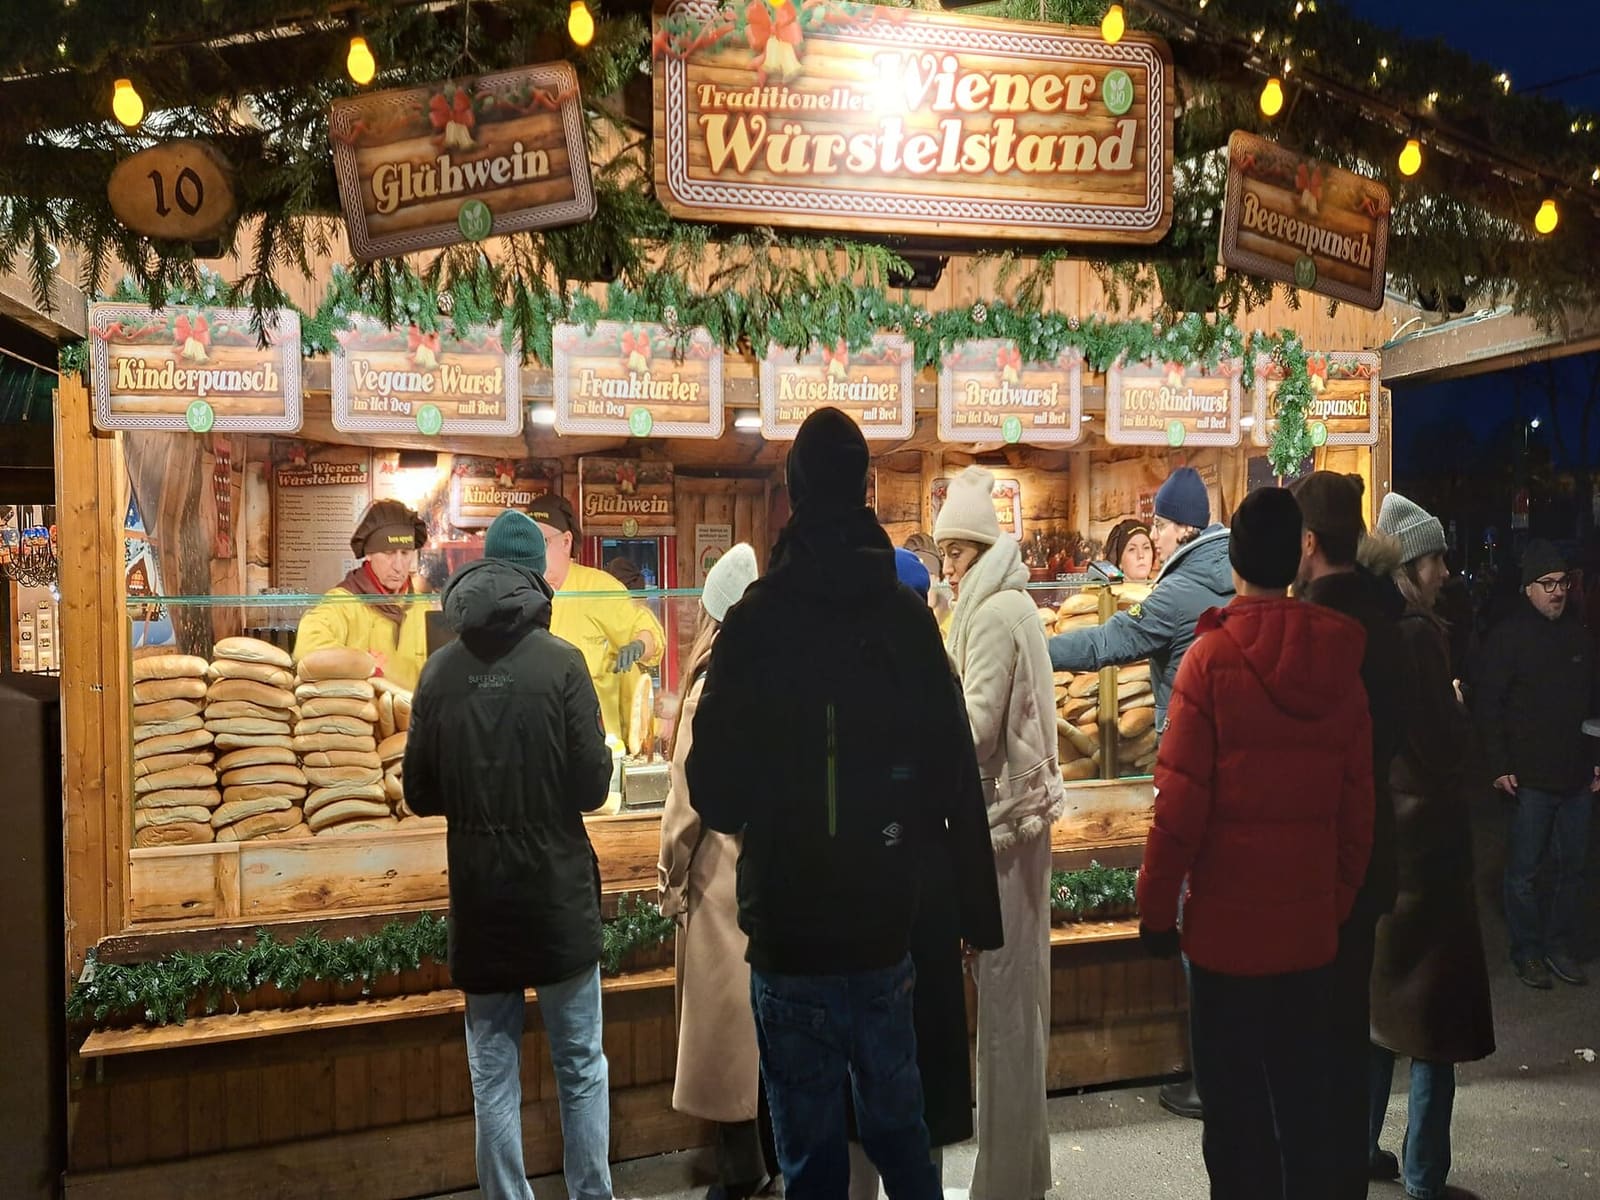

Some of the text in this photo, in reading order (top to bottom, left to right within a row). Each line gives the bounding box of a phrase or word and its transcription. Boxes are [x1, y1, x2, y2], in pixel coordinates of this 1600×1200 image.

[697, 51, 1096, 112] Traditioneller Wiener
[699, 114, 1138, 174] Würstelstand
[371, 141, 550, 214] Glühwein
[147, 167, 204, 217] 10
[1243, 191, 1372, 269] Beerenpunsch
[117, 358, 278, 397] Kinderpunsch
[352, 360, 503, 396] Vegane Wurst
[580, 369, 700, 401] Frankfurter
[779, 373, 899, 401] Käsekrainer
[390, 398, 412, 415] Dog
[965, 380, 1059, 407] Bratwurst
[1124, 386, 1229, 413] 100% Rindwurst
[458, 400, 499, 415] mit Brot
[606, 402, 625, 417] Dog
[879, 407, 897, 420] Brot
[983, 412, 1000, 426] Dog
[1048, 411, 1066, 425] Brot
[1149, 415, 1164, 429] Dog
[1210, 416, 1227, 429] Brot
[312, 463, 359, 474] Wiener
[584, 494, 669, 516] Glühwein
